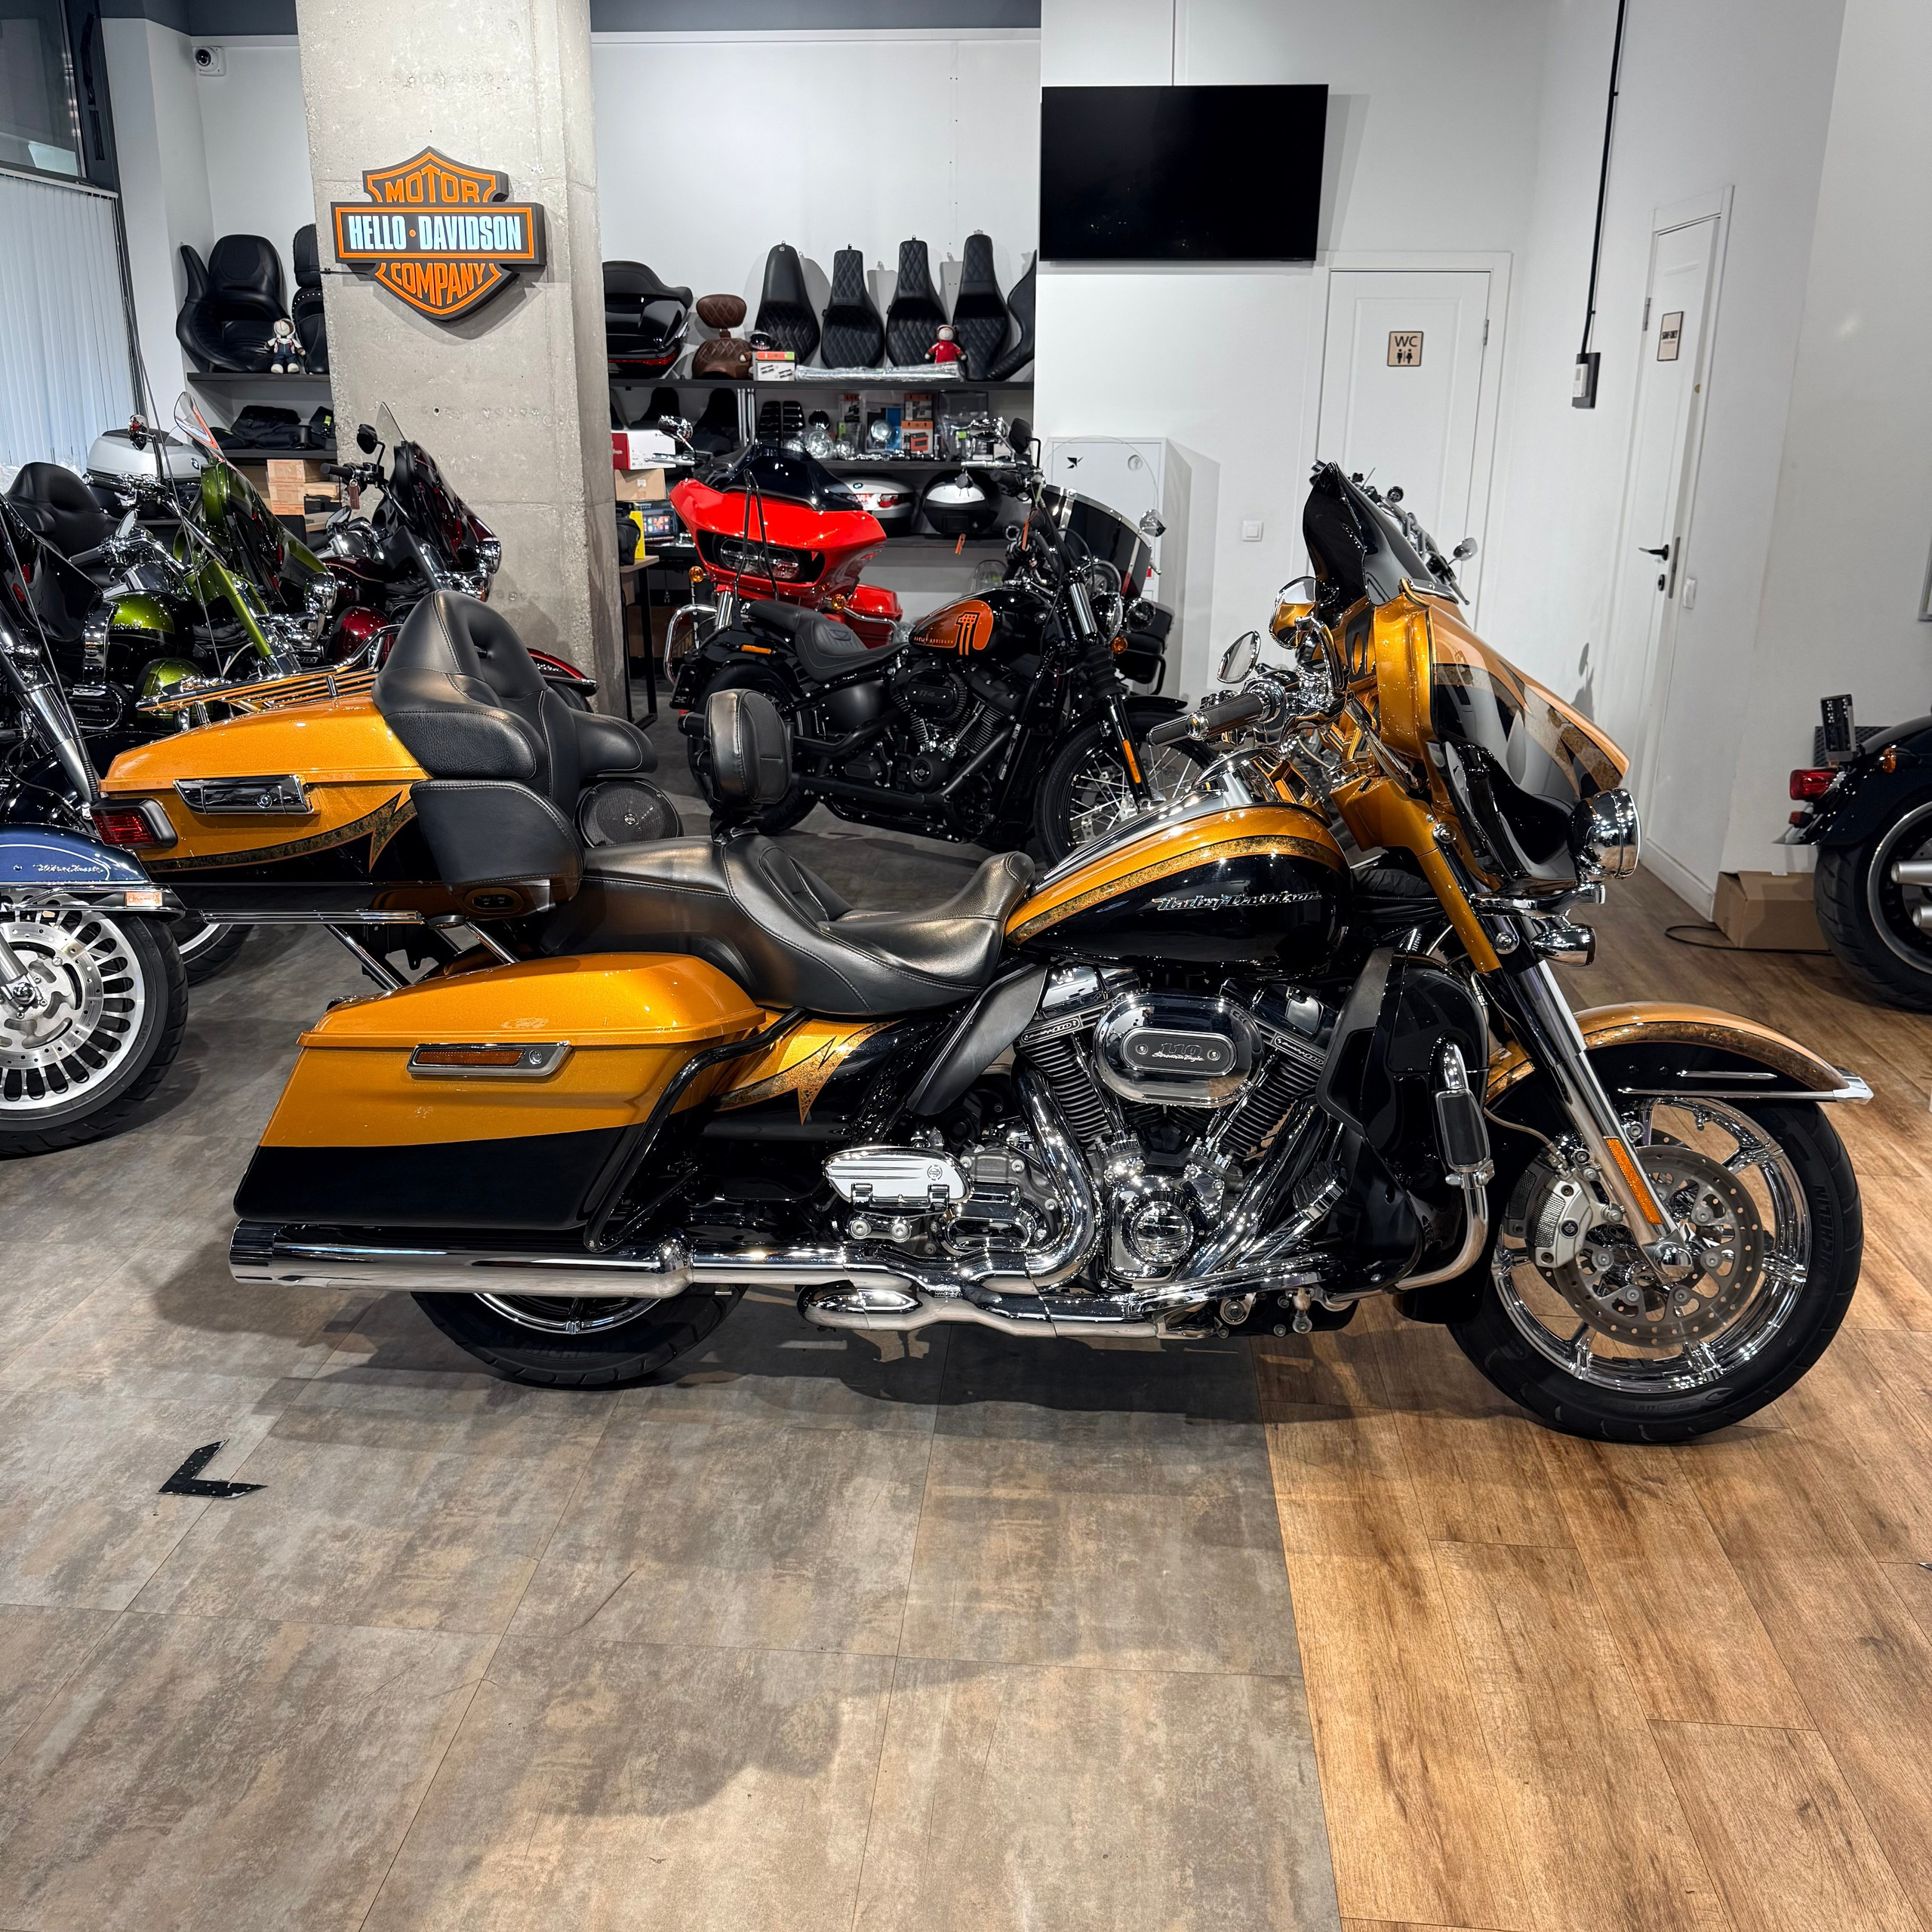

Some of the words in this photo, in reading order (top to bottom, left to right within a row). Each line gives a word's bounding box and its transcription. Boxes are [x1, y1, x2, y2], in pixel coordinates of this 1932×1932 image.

[385, 163, 480, 203] MOTOR
[348, 215, 408, 250] HELLO
[417, 216, 522, 251] DAVIDSON
[389, 263, 486, 306] COMPANY
[1394, 336, 1419, 347] WC
[1161, 1042, 1202, 1057] 110
